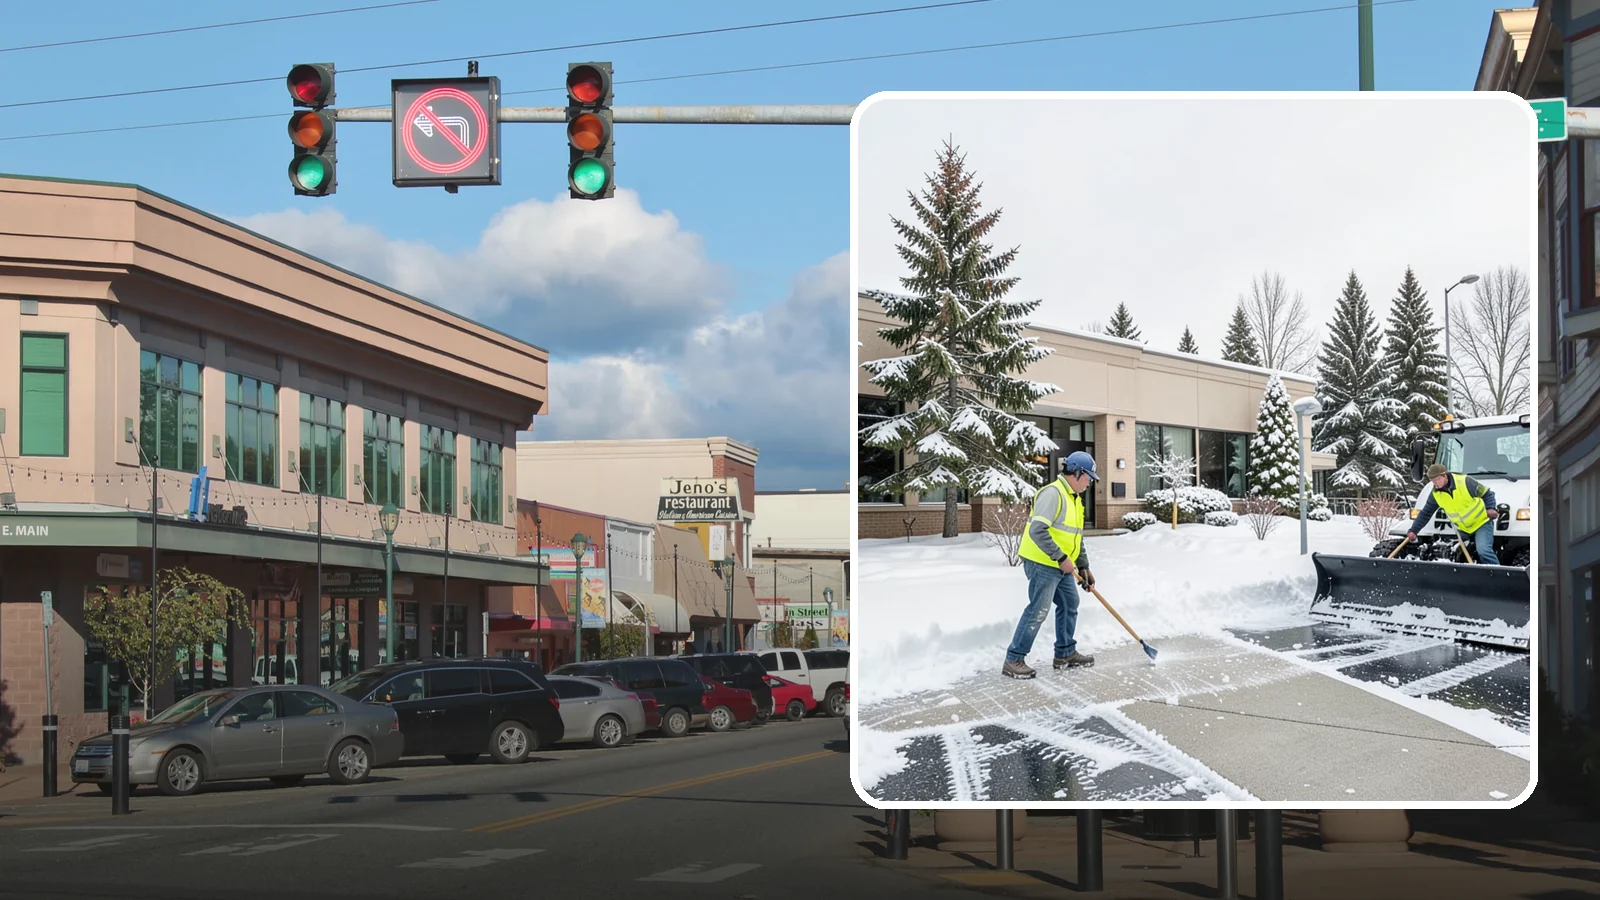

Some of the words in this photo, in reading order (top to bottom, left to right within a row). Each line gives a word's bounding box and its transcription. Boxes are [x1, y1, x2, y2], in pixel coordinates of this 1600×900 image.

[669, 480, 728, 494] Jeno's
[665, 496, 731, 509] restaurant
[686, 510, 714, 519] American
[714, 509, 738, 519] Cuisine
[2, 525, 13, 536] E.
[15, 525, 49, 536] MAIN
[797, 607, 829, 616] Street
[790, 619, 824, 627] lass
